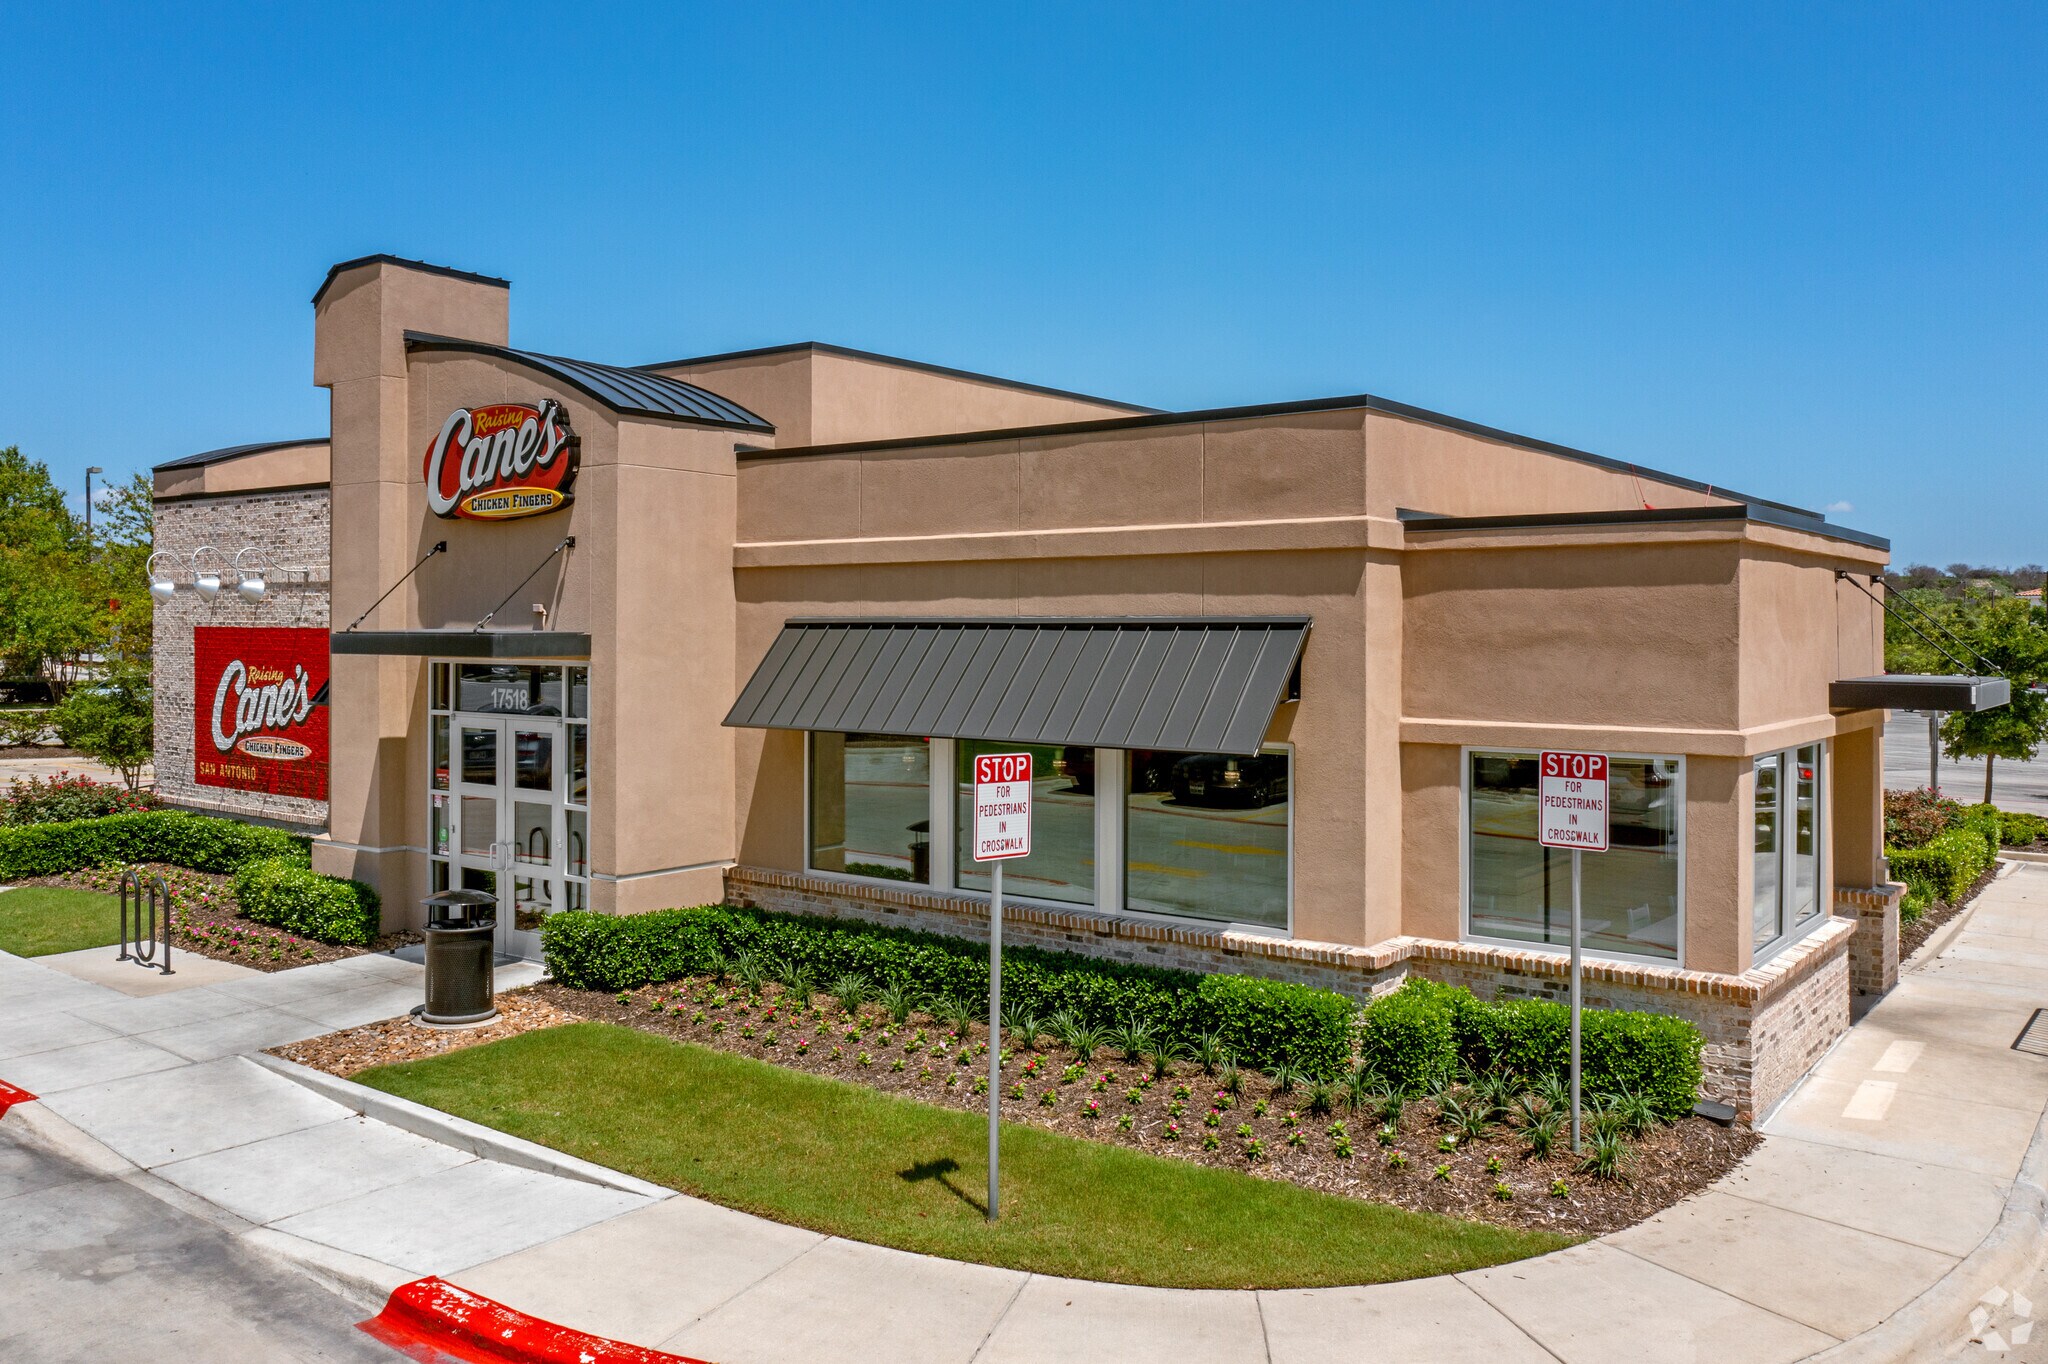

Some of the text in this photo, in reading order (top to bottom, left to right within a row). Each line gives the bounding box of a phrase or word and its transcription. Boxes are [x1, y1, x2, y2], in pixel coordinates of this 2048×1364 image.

[475, 409, 524, 434] Raising
[427, 399, 568, 515] Cane's
[471, 493, 553, 512] CHICKEN FINGERS
[247, 666, 284, 687] Raising
[211, 659, 313, 751] Cane's
[491, 687, 528, 711] 17518
[244, 740, 304, 757] CHICKEN FINGERS
[199, 761, 257, 781] SAN ANTONIO
[981, 757, 1027, 783] STOP
[1546, 753, 1602, 778] STOP
[996, 786, 1010, 798] FOR
[1565, 781, 1582, 793] FOR
[979, 802, 1027, 817] PEDESTRIANS
[1545, 795, 1603, 811] PEDESTRIANS
[999, 821, 1006, 833] IN
[1568, 814, 1577, 825] IN
[981, 837, 1023, 853] CROSSWALK
[1548, 828, 1599, 844] CROSSWALK
